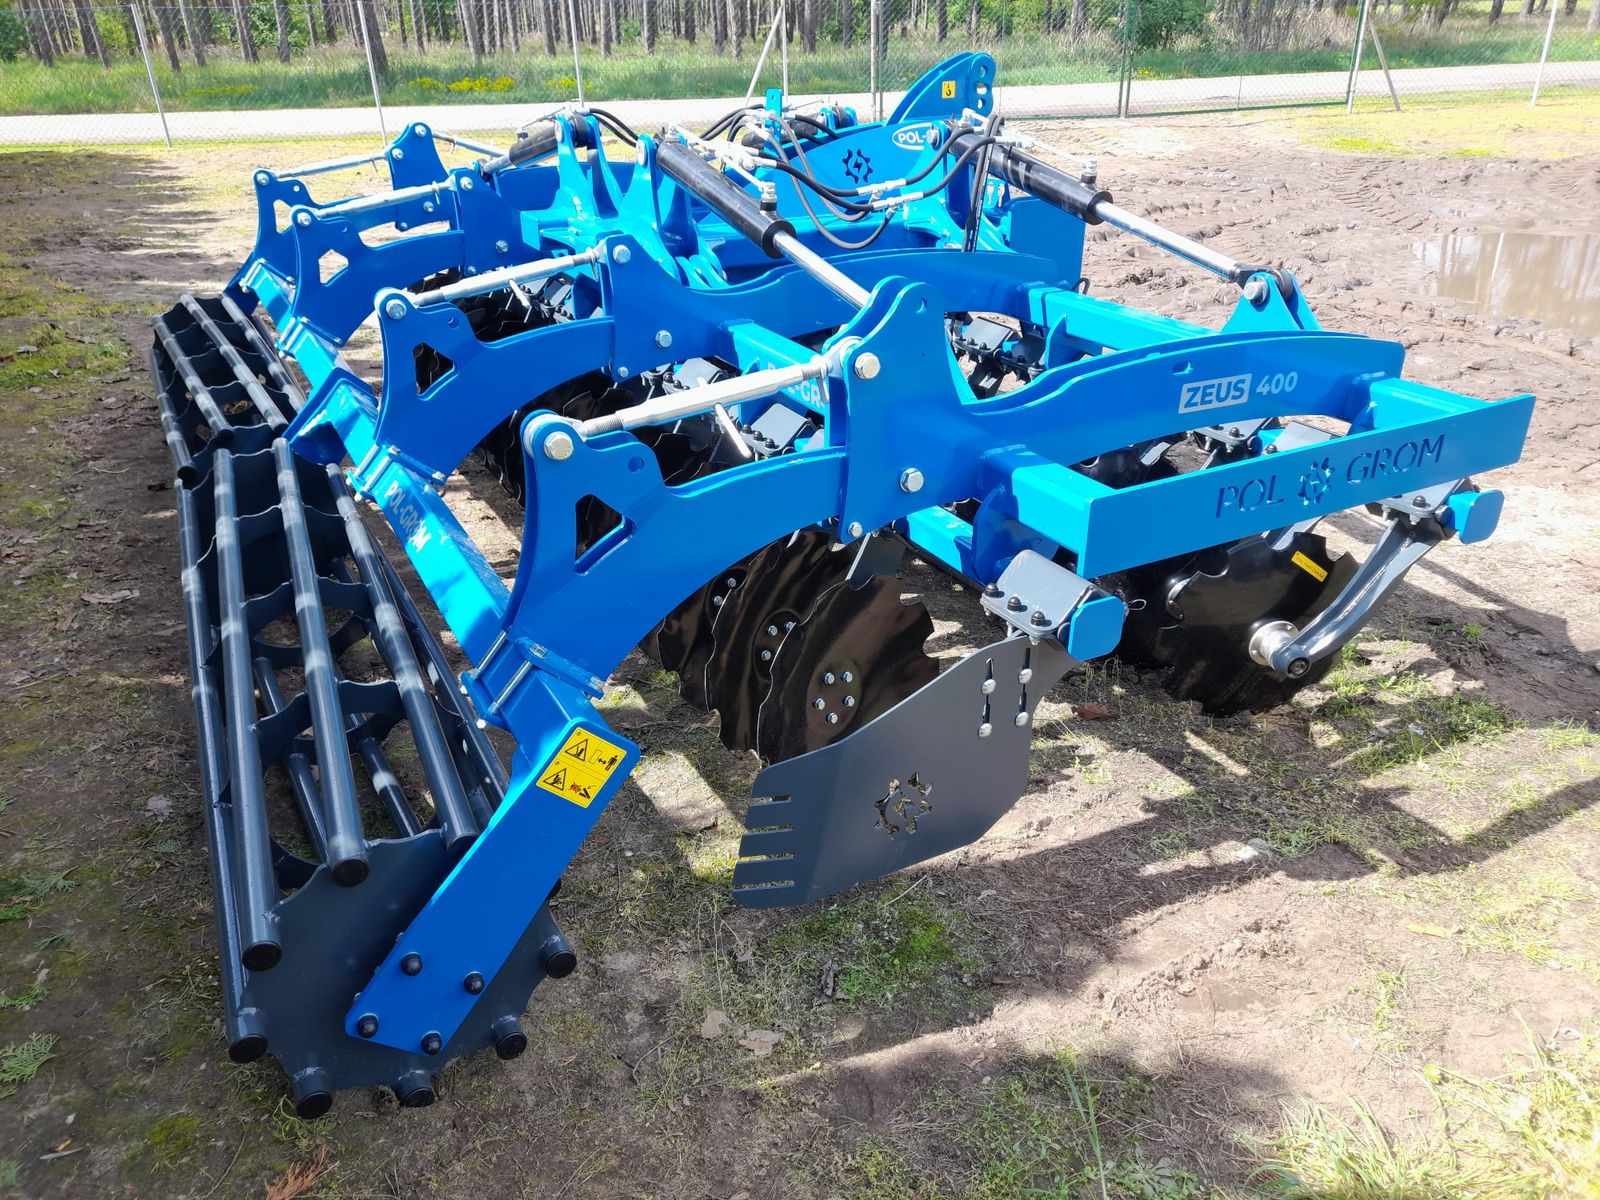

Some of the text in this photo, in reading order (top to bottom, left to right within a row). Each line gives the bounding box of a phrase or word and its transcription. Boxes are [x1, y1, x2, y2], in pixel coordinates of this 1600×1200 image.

[1183, 371, 1299, 409] ZEUS 400
[1215, 433, 1446, 519] POL GROM
